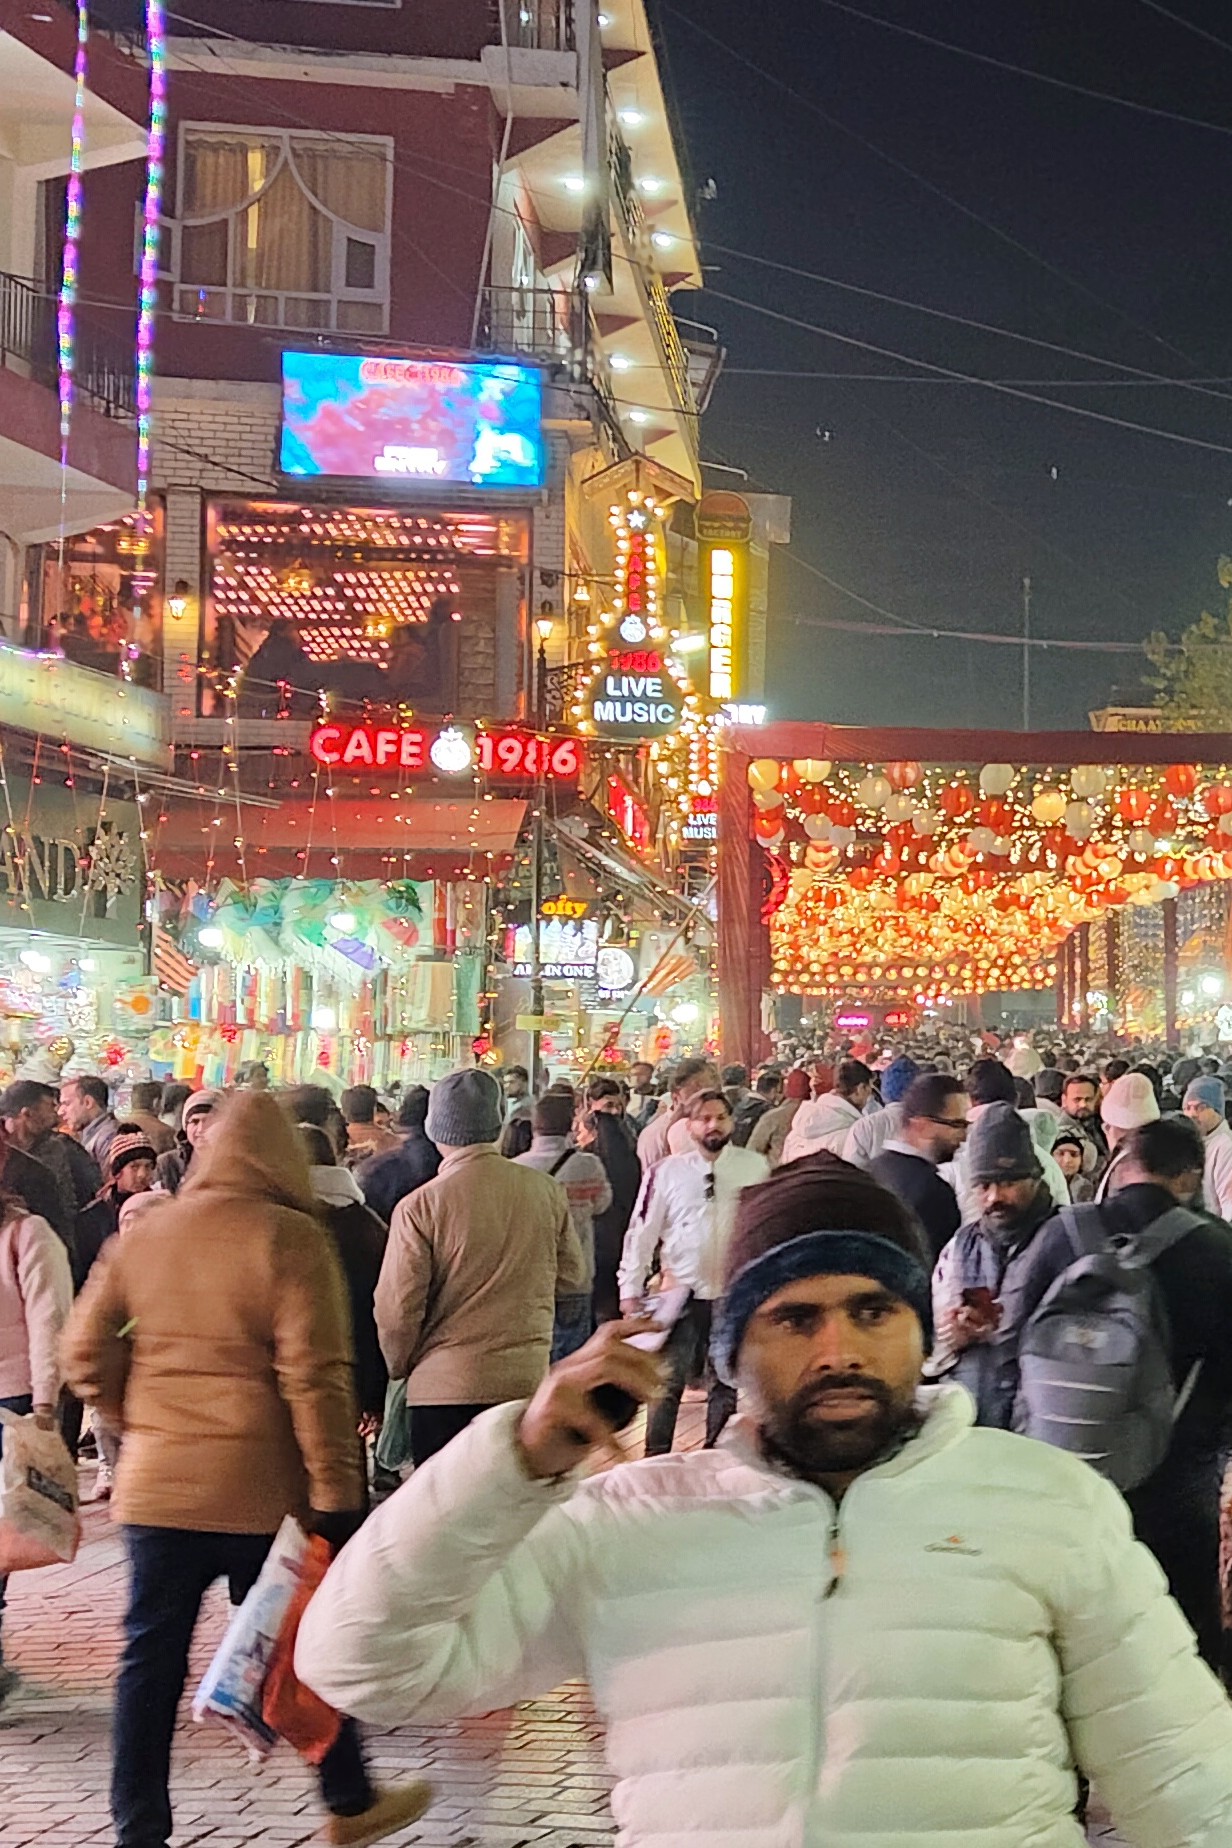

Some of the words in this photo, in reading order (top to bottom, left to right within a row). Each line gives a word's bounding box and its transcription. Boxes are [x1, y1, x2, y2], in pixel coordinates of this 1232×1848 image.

[605, 674, 664, 698] LIVE
[592, 700, 676, 724] MUSIC
[310, 727, 424, 768] CAFE
[475, 736, 578, 775] 1986
[687, 812, 718, 826] LIVE
[681, 826, 718, 840] MUSI
[541, 895, 589, 918] ofty
[562, 964, 596, 979] ONE
